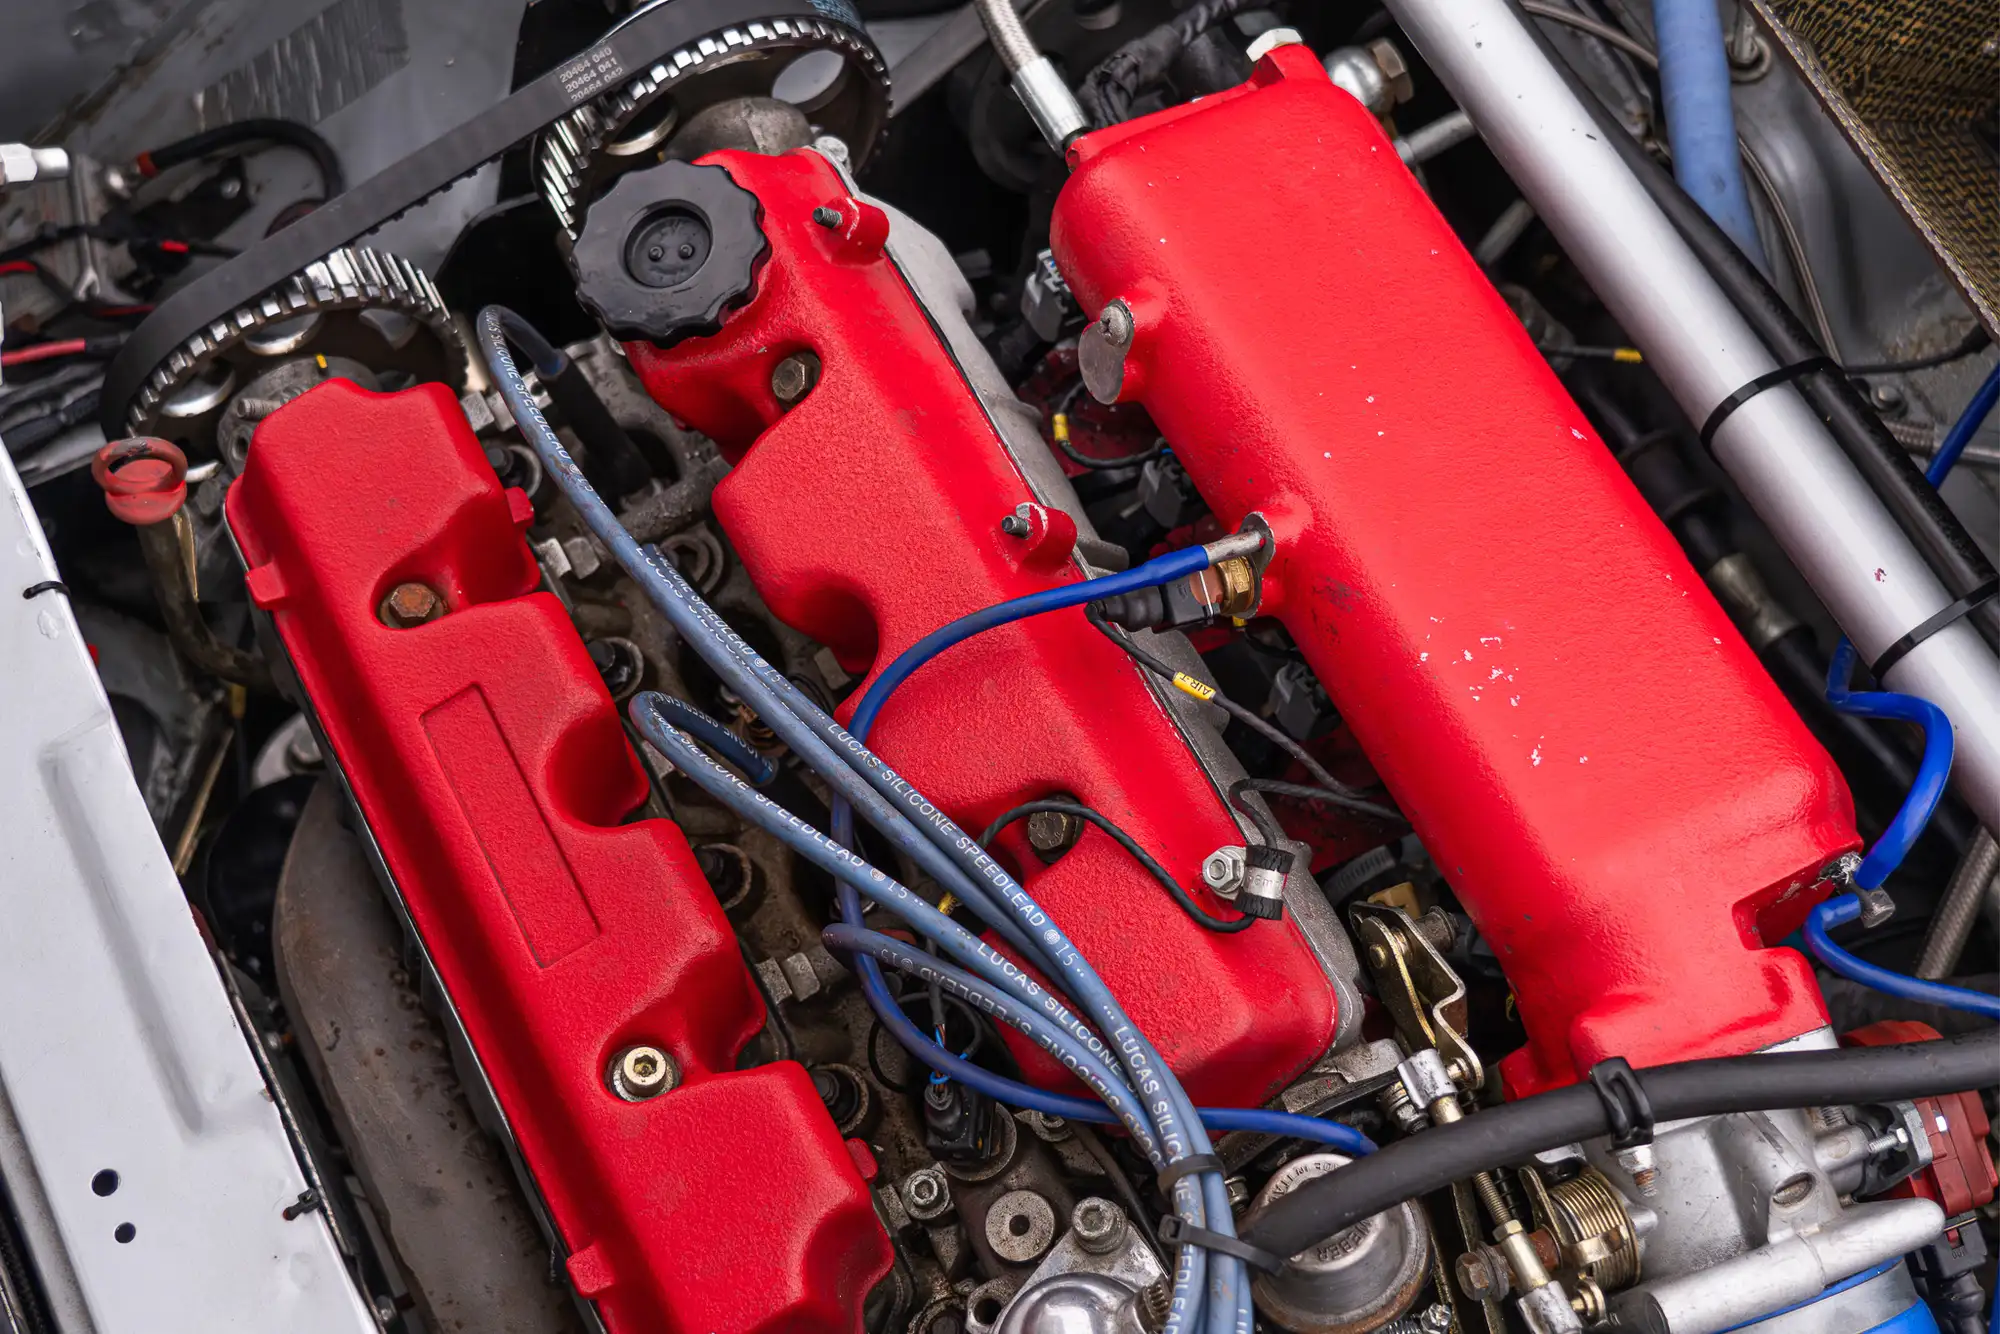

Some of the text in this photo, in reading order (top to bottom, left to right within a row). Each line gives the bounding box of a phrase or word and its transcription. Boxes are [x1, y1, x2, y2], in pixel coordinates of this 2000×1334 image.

[560, 47, 612, 83] 20464 040
[565, 57, 618, 93] 20464 041
[827, 722, 882, 770] LUCAS
[881, 768, 957, 836] SILICONE
[955, 836, 1046, 927] SPEEDLEAD
[1053, 942, 1081, 967] 15
[976, 942, 1123, 1076] LUCAS SILICONE
[1113, 1025, 1160, 1094] LUCAS
